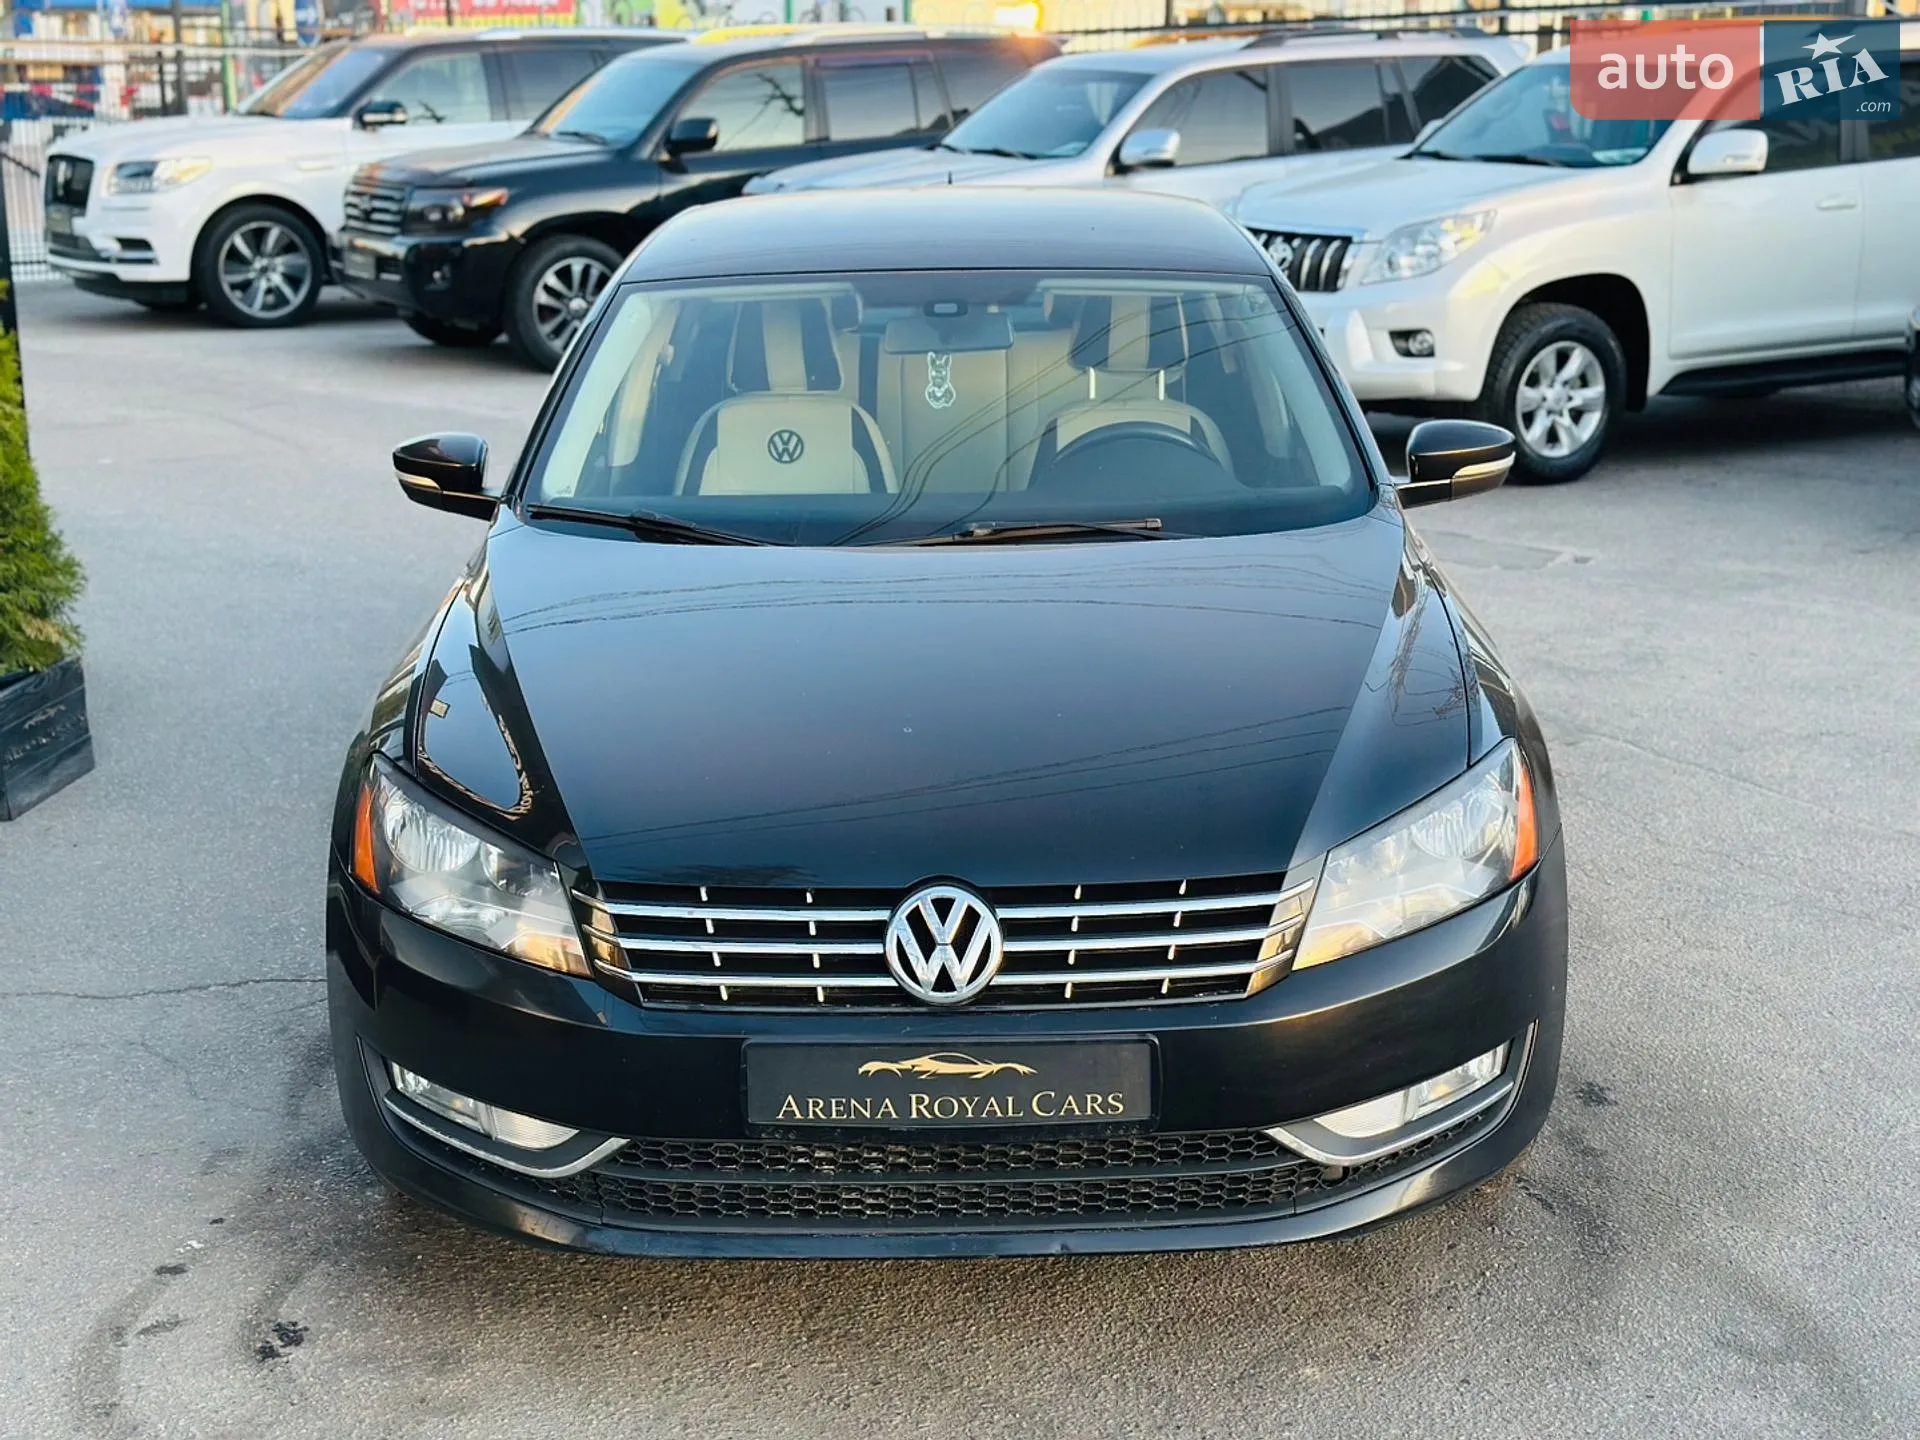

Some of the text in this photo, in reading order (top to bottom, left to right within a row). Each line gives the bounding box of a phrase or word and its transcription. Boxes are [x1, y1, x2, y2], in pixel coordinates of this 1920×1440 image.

[885, 885, 1004, 1004] VW
[775, 1090, 1125, 1120] ARENA ROYAL CARS
